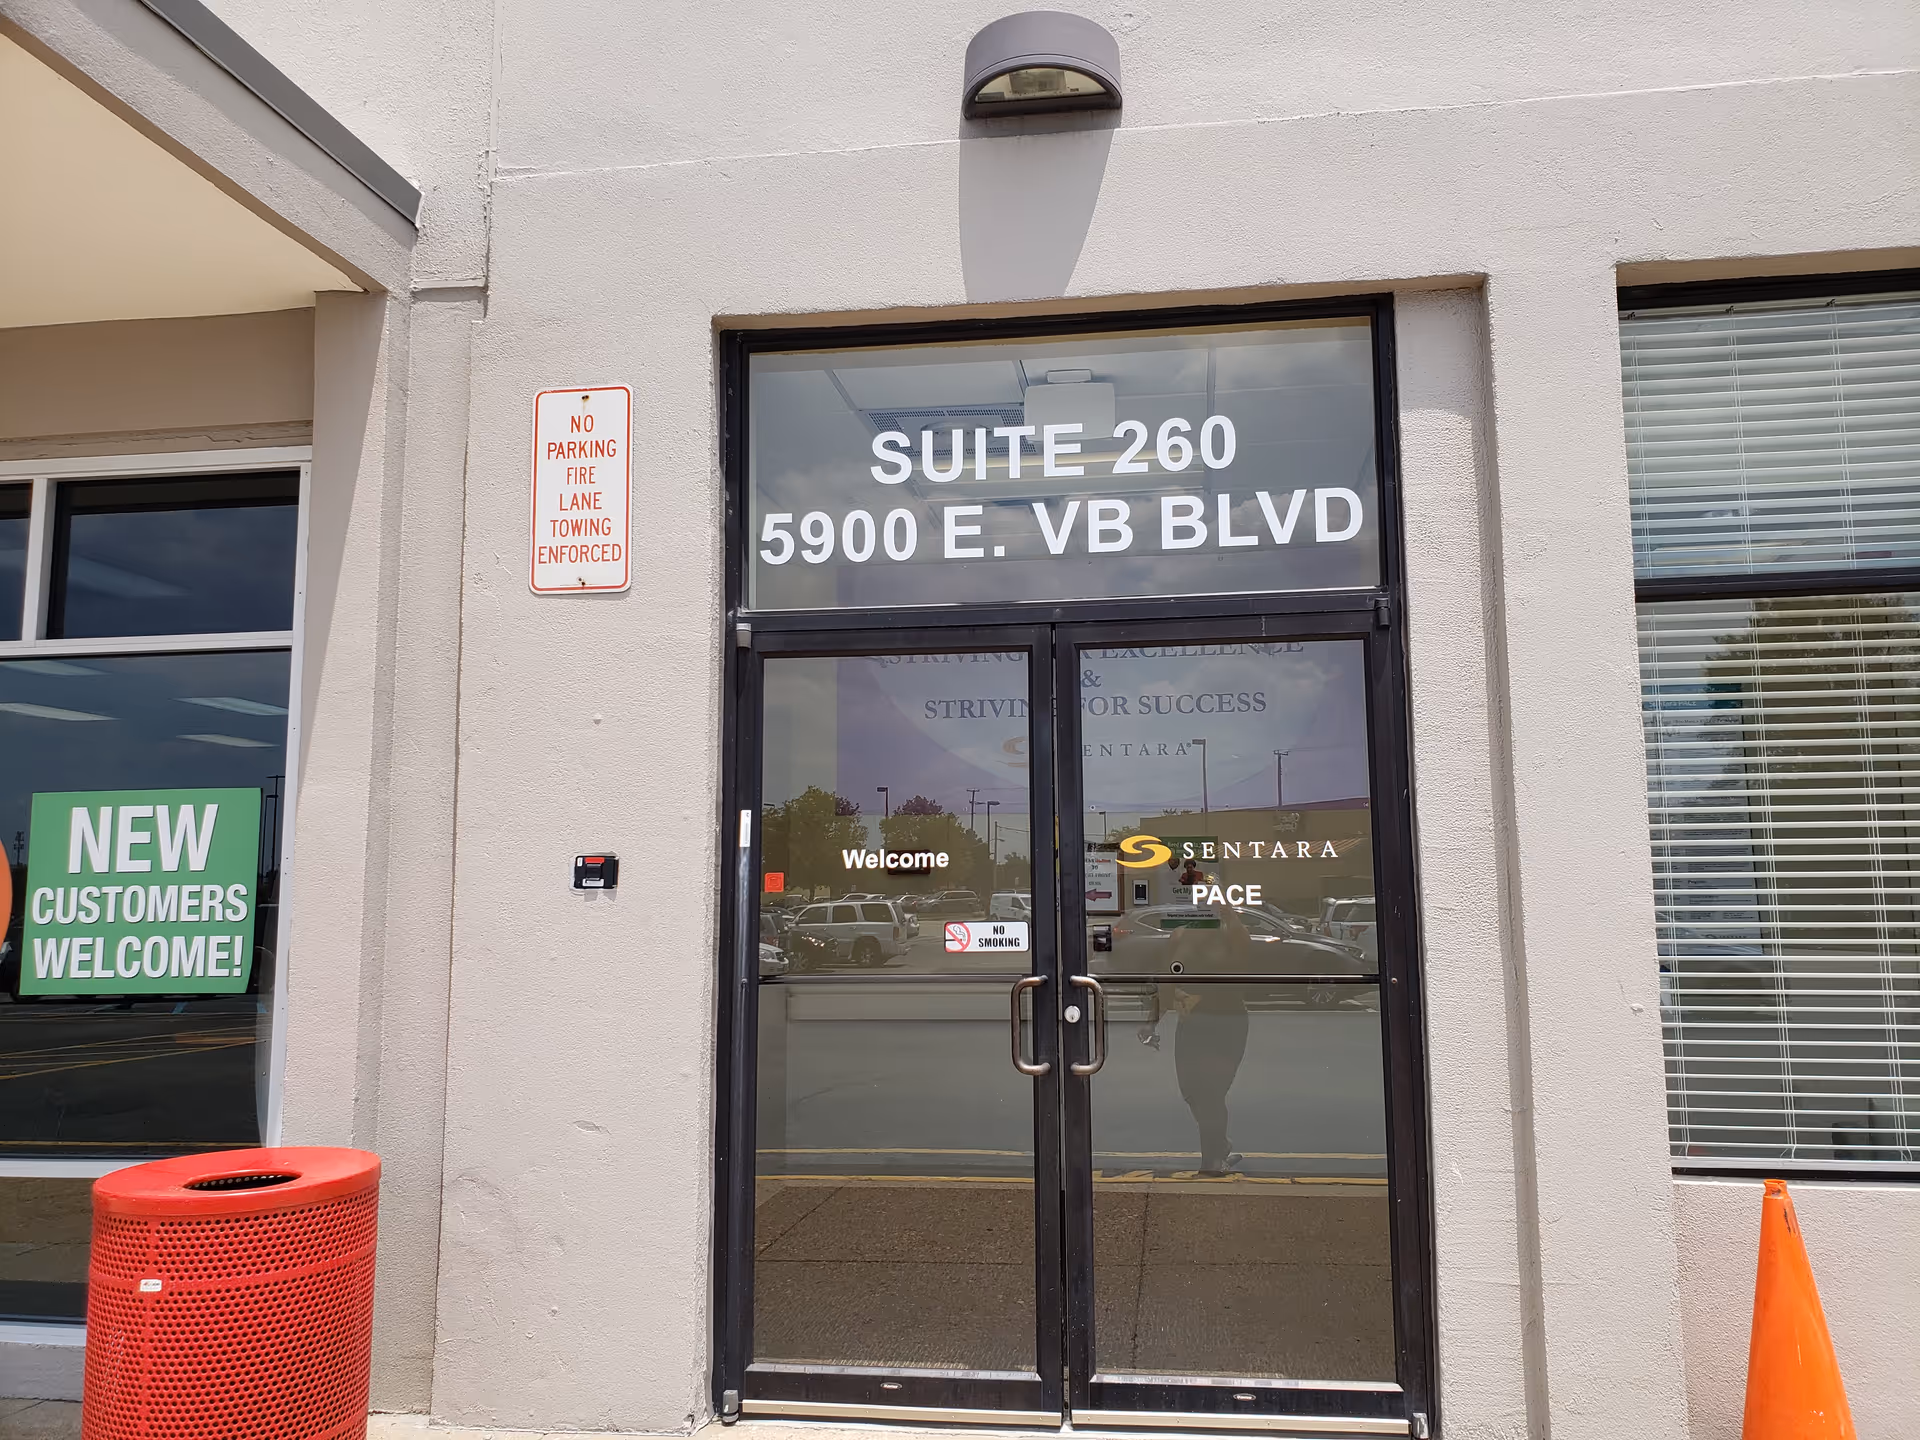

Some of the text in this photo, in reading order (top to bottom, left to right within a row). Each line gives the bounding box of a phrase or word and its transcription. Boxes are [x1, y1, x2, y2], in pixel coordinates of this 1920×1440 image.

[571, 415, 594, 433] NO
[547, 439, 617, 460] PARKING
[870, 414, 1237, 485] SUITE 260
[566, 466, 596, 485] FIRE
[559, 492, 602, 511] LANE
[550, 517, 611, 537] TOWING
[759, 486, 1364, 565] 5900 E. VB BLVD
[538, 543, 622, 564] ENFORCED
[1081, 669, 1102, 688] &
[924, 698, 1028, 719] STRIVIN
[1138, 691, 1267, 715] SUCCESS
[68, 803, 219, 874] NEW
[842, 849, 950, 869] Welcome
[1183, 840, 1338, 860] SENTARA
[32, 883, 248, 925] CUSTOMERS
[1192, 884, 1263, 906] PACE
[992, 925, 1005, 935] NO
[978, 937, 1020, 948] SMOKING
[33, 935, 244, 979] WELCOME!
